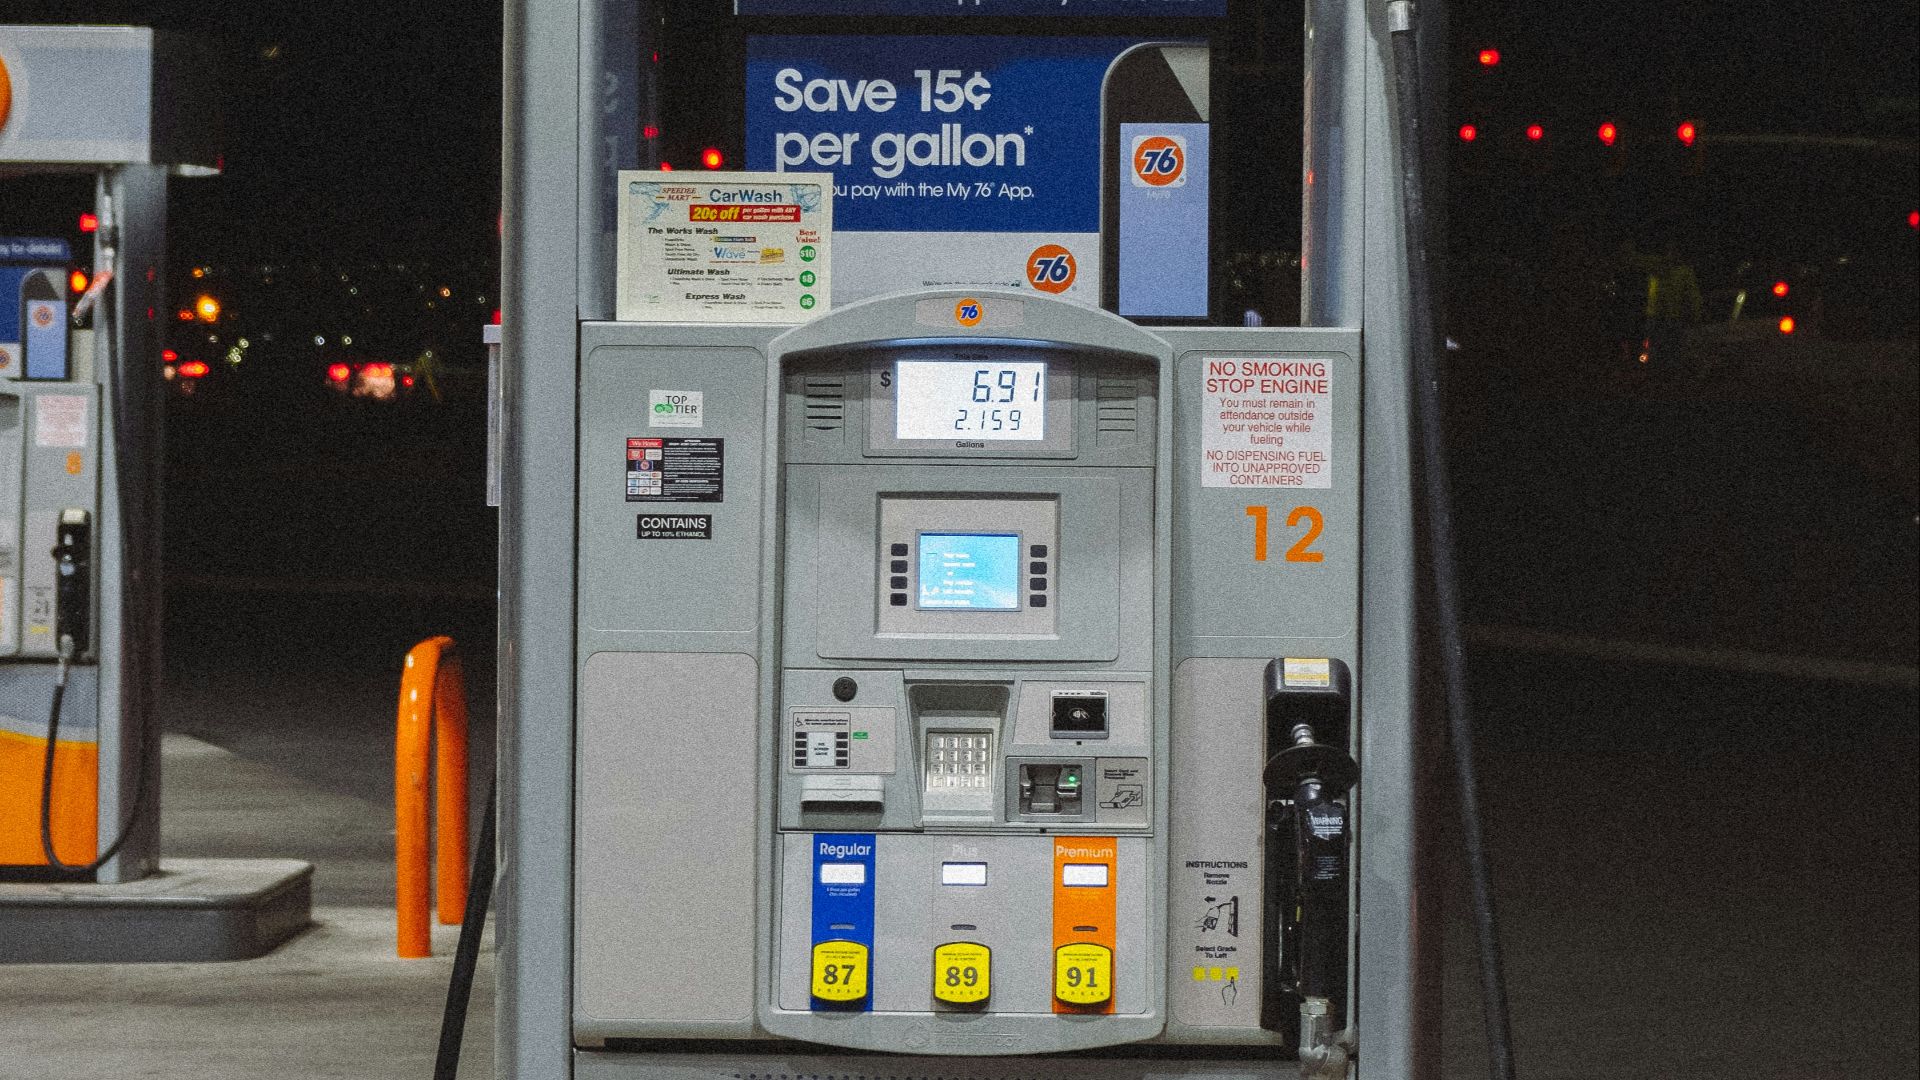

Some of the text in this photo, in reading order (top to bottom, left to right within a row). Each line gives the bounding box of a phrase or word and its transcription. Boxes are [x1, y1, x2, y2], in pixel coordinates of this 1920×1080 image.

[774, 68, 991, 113] Save 15¢
[776, 131, 862, 172] per
[1143, 149, 1177, 175] 76
[710, 189, 782, 203] CarWash
[833, 185, 848, 196] ou
[851, 185, 882, 200] pay
[884, 183, 915, 196] with
[919, 182, 943, 197] the
[947, 183, 971, 201] My
[998, 183, 1034, 201] App.
[720, 207, 739, 219] off
[666, 227, 692, 235] Works
[696, 227, 718, 235] Wash
[668, 268, 705, 276] Ultimate
[1034, 256, 1069, 282] 76
[686, 293, 720, 301] Express
[961, 305, 978, 320] 76
[1210, 362, 1325, 377] NO SMOKING
[880, 370, 1040, 403] $ 6.91
[1206, 379, 1328, 394] STOP ENGINE
[665, 395, 688, 405] TOP
[1219, 398, 1315, 408] You must remain in
[674, 404, 697, 414] TIER
[955, 409, 1021, 431] 2.159
[1220, 411, 1314, 421] attendance outside
[1222, 423, 1311, 434] your vehicle while
[956, 441, 985, 449] Gallons
[1250, 434, 1284, 446] fueling
[1206, 451, 1327, 462] NO DISPENSING FUEL
[1213, 463, 1321, 474] INTO UNAPPROVED
[1230, 475, 1303, 486] CONTAINERS
[641, 517, 707, 529] CONTAINS
[1246, 506, 1324, 563] 12
[1312, 816, 1343, 825] WARNING
[820, 843, 871, 859] Regular
[952, 844, 978, 857] Plus
[1056, 846, 1113, 858] Premium
[1185, 861, 1248, 869] INSTRUCTIONS
[823, 964, 856, 985] 87
[946, 966, 978, 987] 89
[1067, 966, 1098, 987] 91
